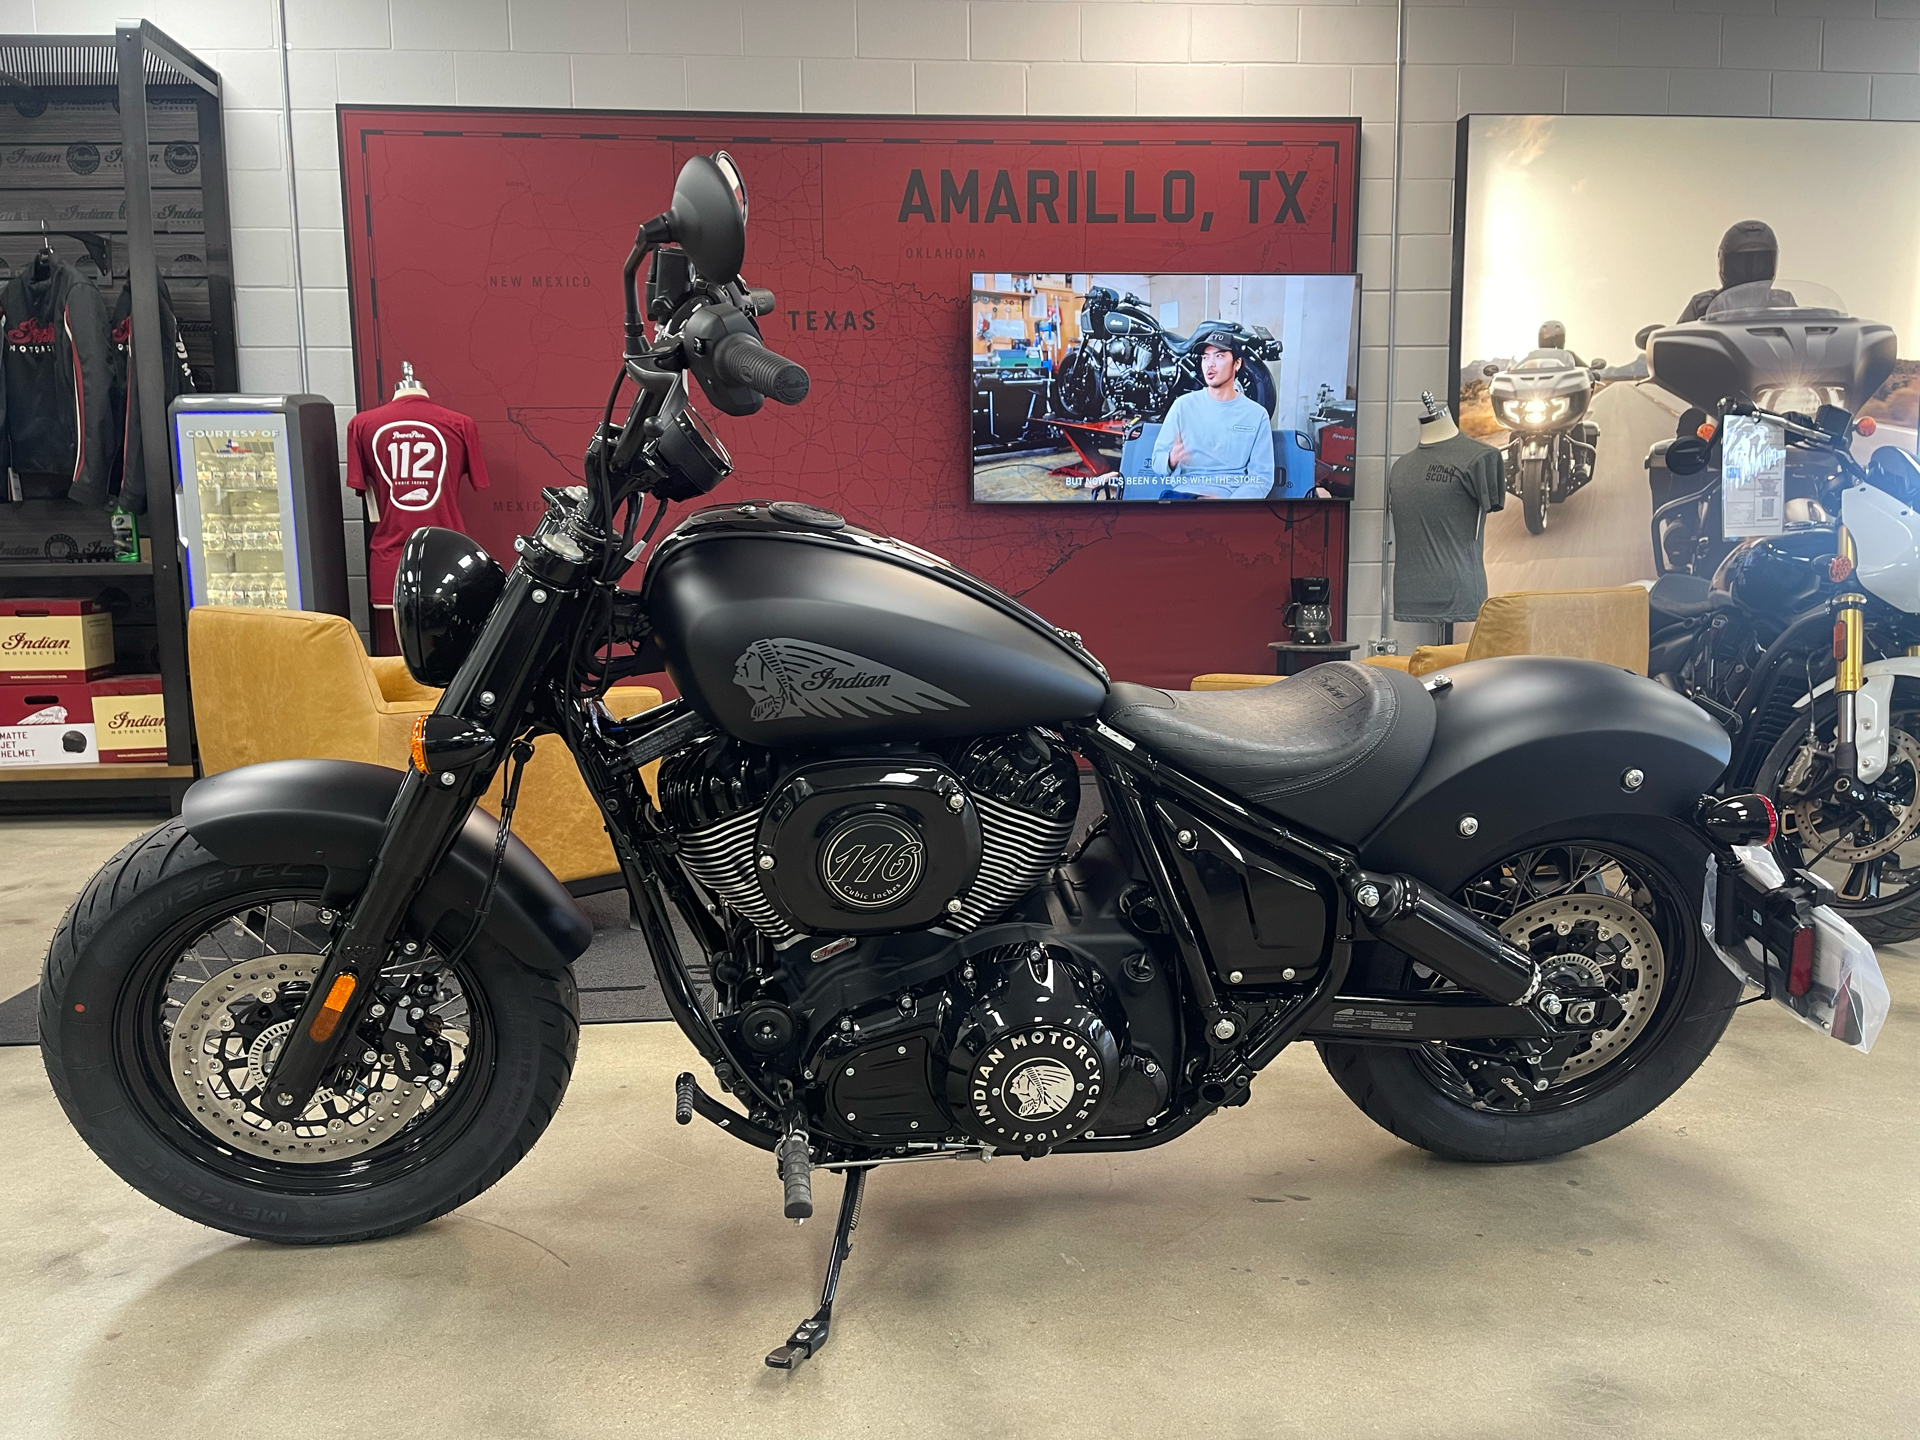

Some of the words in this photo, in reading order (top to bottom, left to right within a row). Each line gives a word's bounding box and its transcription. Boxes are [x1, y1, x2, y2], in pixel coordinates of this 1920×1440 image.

[6, 148, 61, 164] Indian
[898, 169, 1214, 232] AMARILLO,
[1239, 170, 1308, 224] TX
[905, 247, 986, 259] OKLAHOMA
[489, 276, 521, 287] NEW
[532, 276, 591, 288] MEXICO
[787, 310, 876, 331] TEXAS
[185, 429, 257, 438] COURTESY
[261, 429, 280, 438] OF
[387, 441, 436, 480] 112
[1427, 464, 1457, 475] INDIAN
[1065, 477, 1084, 486] BUT
[1085, 477, 1107, 486] NOW
[1108, 477, 1124, 486] IT'S
[1126, 476, 1150, 485] BEEN
[1152, 476, 1158, 485] 6
[1160, 476, 1187, 485] YEARS
[1190, 476, 1212, 485] WITH
[1215, 476, 1231, 485] THE
[1233, 476, 1265, 485] STORE.
[1425, 473, 1454, 483] SCOUT
[0, 541, 39, 556] ndian
[1, 632, 71, 650] Indian
[801, 667, 892, 692] Indian
[0, 731, 28, 740] MATTE
[1, 740, 16, 749] JET
[1, 750, 36, 758] HELMET
[828, 841, 923, 883] 116
[843, 885, 869, 900] Cubic
[872, 883, 902, 900] Inches
[395, 1041, 412, 1071] Indian
[973, 1048, 1005, 1125] INDIAN
[1010, 1031, 1101, 1120] MOTORCYCLE
[1011, 1129, 1059, 1143] 1901
